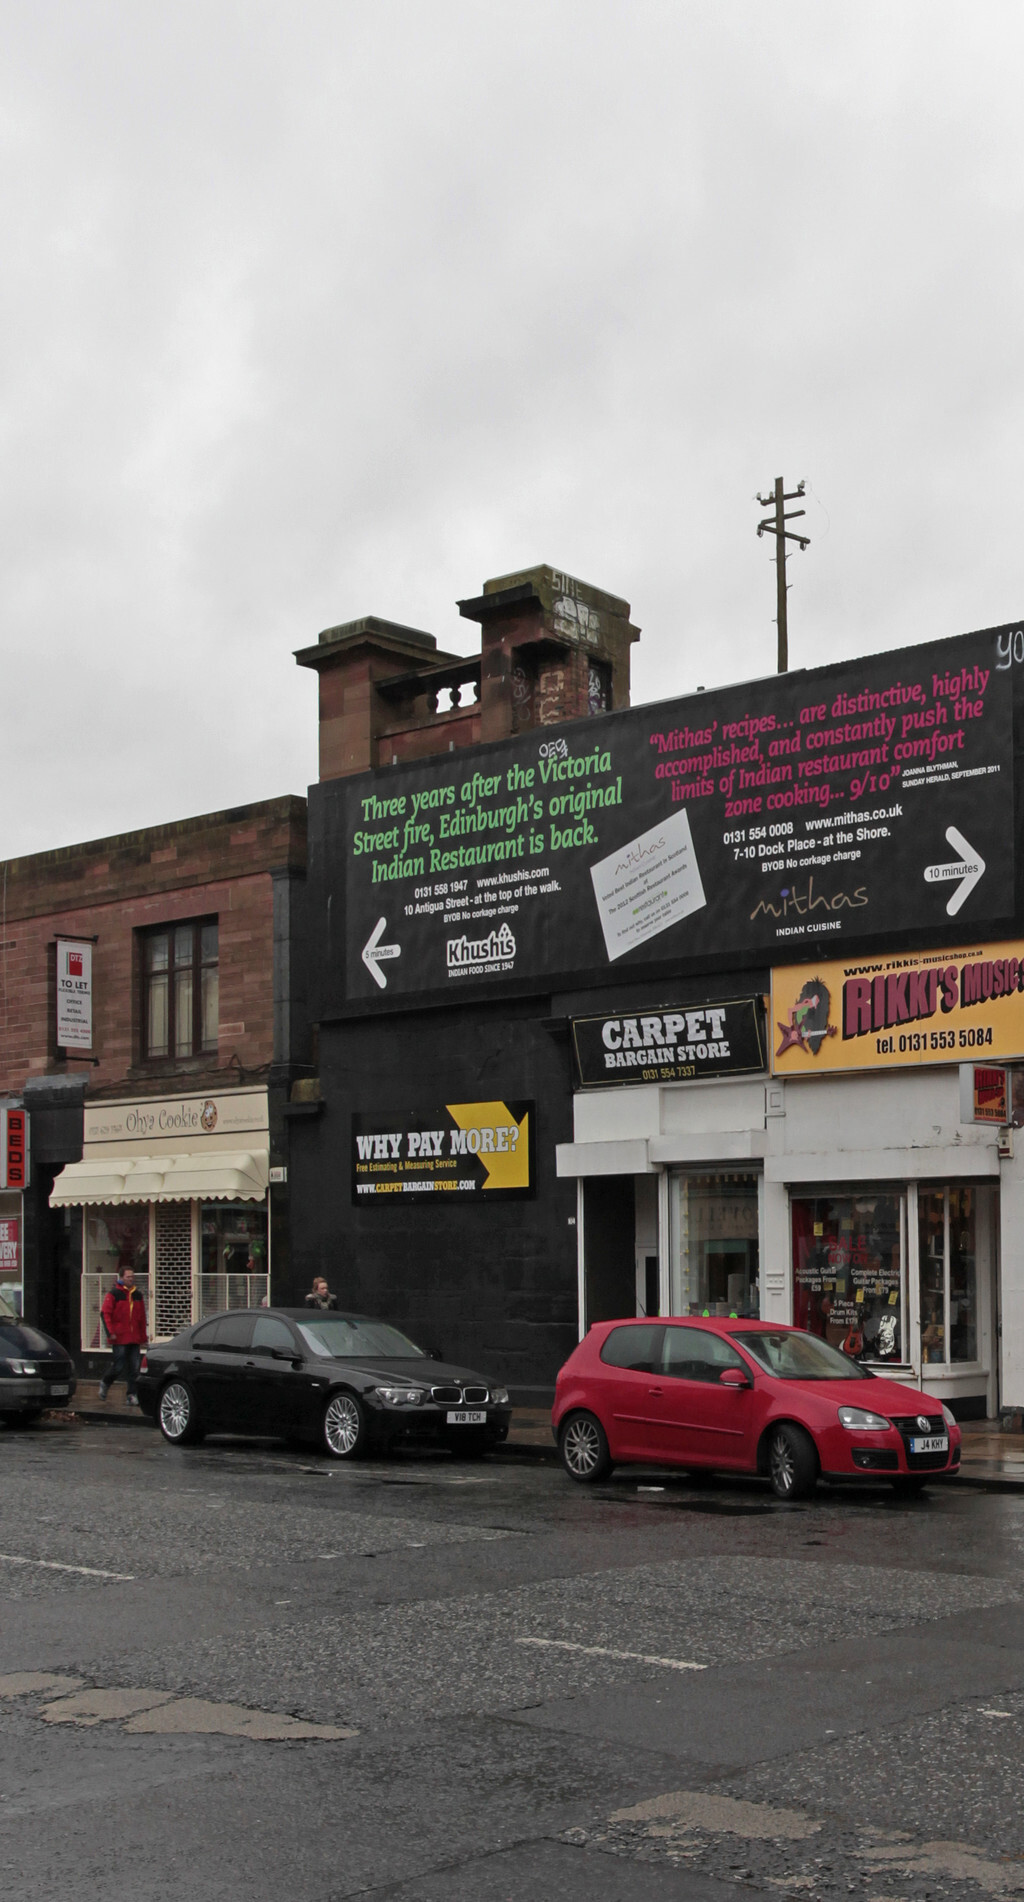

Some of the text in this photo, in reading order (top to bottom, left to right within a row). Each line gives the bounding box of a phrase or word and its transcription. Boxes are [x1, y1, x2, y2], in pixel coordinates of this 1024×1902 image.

[800, 703, 827, 724] are
[831, 681, 926, 718] distinctive,
[932, 665, 990, 700] highly
[655, 697, 984, 779] accomplished, and constantly push the
[671, 728, 965, 802] limits of Indian restaurant comfort
[902, 761, 958, 777] JOANNA BLYTHMAN,
[902, 765, 1000, 788] SUNDAY HERALD, SEPTEMBER 2011
[361, 745, 612, 822] Three years after the Victoria
[353, 776, 622, 855] Street fire, Edinburgh's original
[724, 796, 762, 818] zone
[805, 803, 903, 831] www.mithas.co.uk
[723, 821, 794, 845] 0131 554 0008
[733, 826, 891, 861] 7-10 Dock Place at the Shore.
[371, 818, 599, 883] Indian Restaurant is back.
[761, 849, 862, 873] BYOB No corkage charge
[476, 867, 550, 888] www.khushis.com
[929, 864, 979, 879] 10 minutes
[404, 879, 561, 917] 10 Antigua Street at the top of the walk.
[414, 880, 468, 899] 0131 558 1947
[750, 875, 869, 921] mithas
[443, 904, 519, 923] BYOB No corkage charge
[776, 921, 842, 937] INDIAN CUISINE
[365, 948, 394, 959] 5 minutes
[448, 932, 516, 966] Khushis
[448, 960, 514, 978] INDIAN FOOD SINCE 1947
[844, 950, 983, 976] www.rikkis-musicshop.co.uk
[61, 980, 88, 990] TO LET
[842, 965, 959, 1041] RIKKI'S
[960, 957, 1019, 1009] MUSIC
[602, 1008, 726, 1050] CARPET
[876, 1027, 993, 1054] tel. 0131 553 5084
[604, 1041, 731, 1068] BARGAIN STORE
[642, 1065, 696, 1080] 0131 554 7337
[158, 1105, 198, 1130] Cookie
[8, 1117, 22, 1181] BEDS
[356, 1125, 519, 1160] WHY PAY MORE?
[356, 1158, 457, 1173] Free Estimating & Measuring Service
[356, 1180, 476, 1194] WWW.CARPETBARGAINSTORE.COM
[829, 1235, 867, 1252] SALE
[828, 1253, 852, 1265] NOW
[851, 1269, 878, 1278] Complete
[853, 1277, 899, 1287] Guitar Packages
[468, 1413, 481, 1422] TCH
[921, 1440, 944, 1450] J4 KHY
